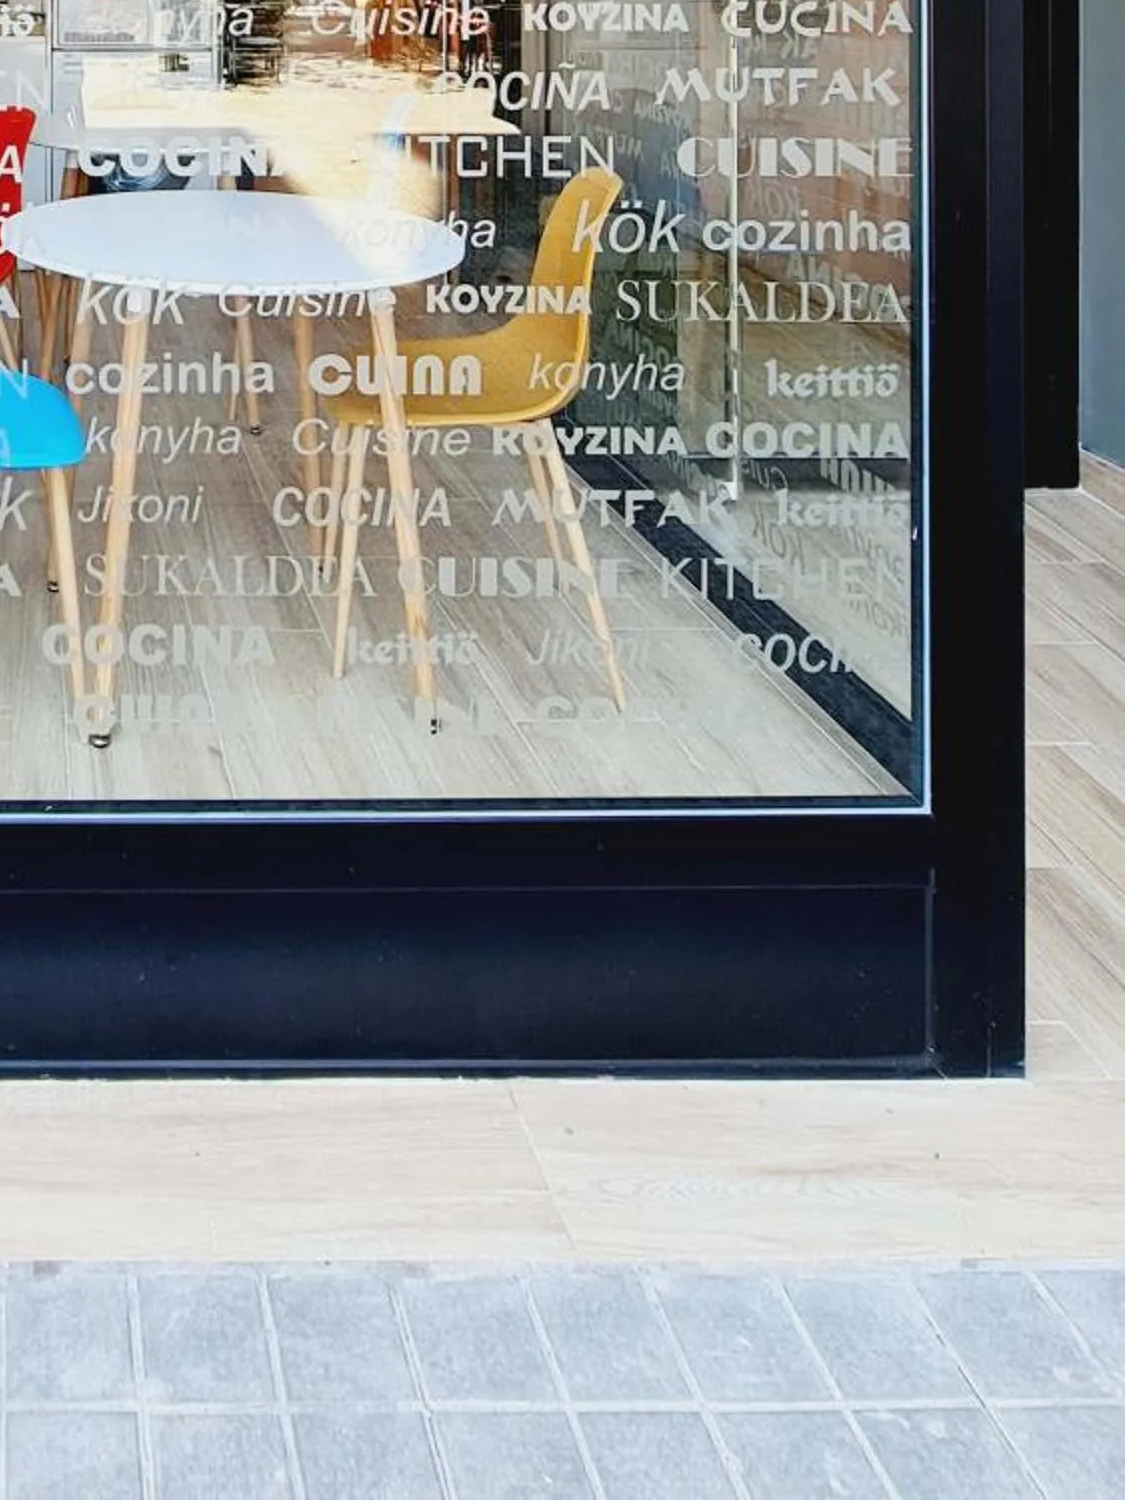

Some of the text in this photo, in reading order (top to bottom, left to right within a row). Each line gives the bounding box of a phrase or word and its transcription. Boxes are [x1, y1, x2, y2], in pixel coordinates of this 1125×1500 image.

[310, 0, 490, 38] Cuisine
[525, 3, 690, 34] KOYZINA
[721, 1, 914, 37] CUCINA
[655, 66, 901, 107] MUTFAK
[676, 136, 914, 178] CUISINE
[571, 199, 687, 254] kök
[702, 210, 912, 253] cozinha
[218, 281, 395, 318] Cuisine
[426, 285, 592, 316] KOYZINA
[615, 279, 911, 325] SUKALDEA
[65, 352, 275, 395] cozinha
[308, 353, 482, 396] CUINA
[528, 354, 685, 400] konyha
[764, 359, 900, 399] keittiö
[85, 417, 243, 462] konyha
[291, 417, 471, 457] Cuisine
[492, 427, 687, 456] KOYZINA
[705, 421, 910, 458] COCINA
[491, 488, 732, 529] MUTFAK
[84, 554, 379, 598] SUKALDEA
[396, 557, 629, 598] CUISINE
[660, 557, 905, 601] KITCHEN
[42, 623, 275, 666] COCINA
